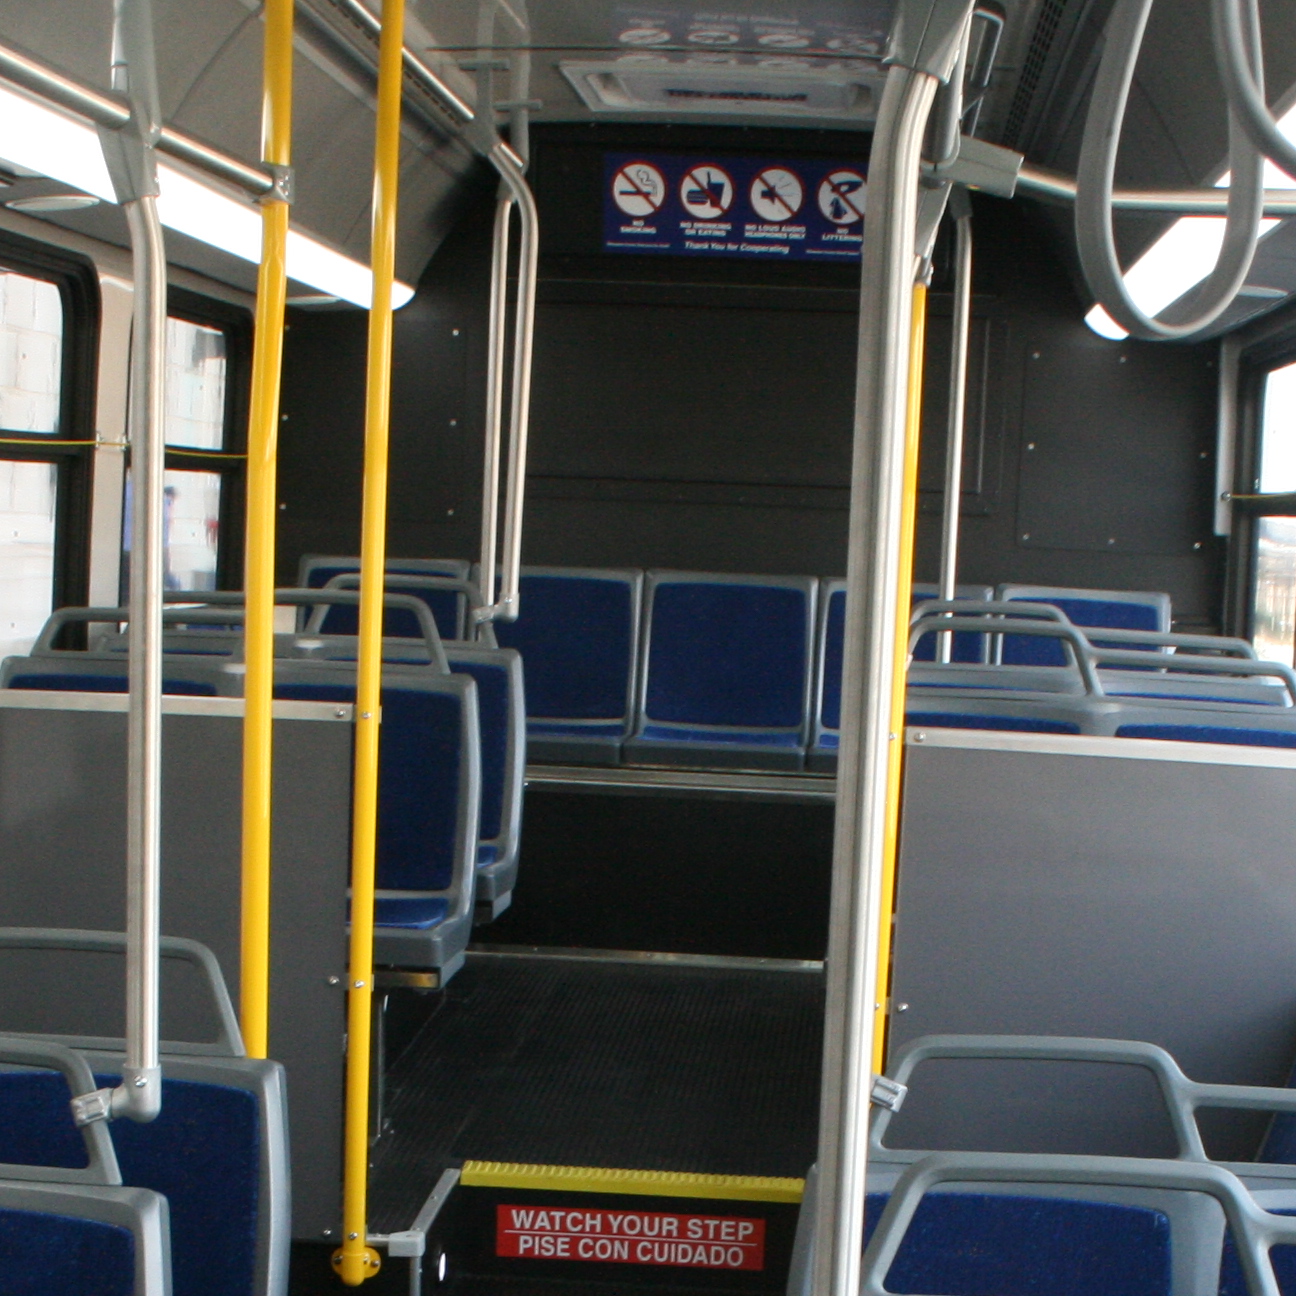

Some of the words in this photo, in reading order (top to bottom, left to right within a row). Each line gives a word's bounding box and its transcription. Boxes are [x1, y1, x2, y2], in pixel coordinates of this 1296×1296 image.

[684, 240, 709, 250] Thank
[710, 241, 726, 251] You
[727, 241, 739, 252] for
[740, 242, 790, 255] Cooperating
[511, 1208, 602, 1233] WATCH
[608, 1213, 679, 1238] YOUR
[686, 1218, 755, 1242] STEP
[518, 1235, 571, 1257] PISE
[577, 1237, 629, 1260] CON
[636, 1241, 744, 1267] CUIDADO
